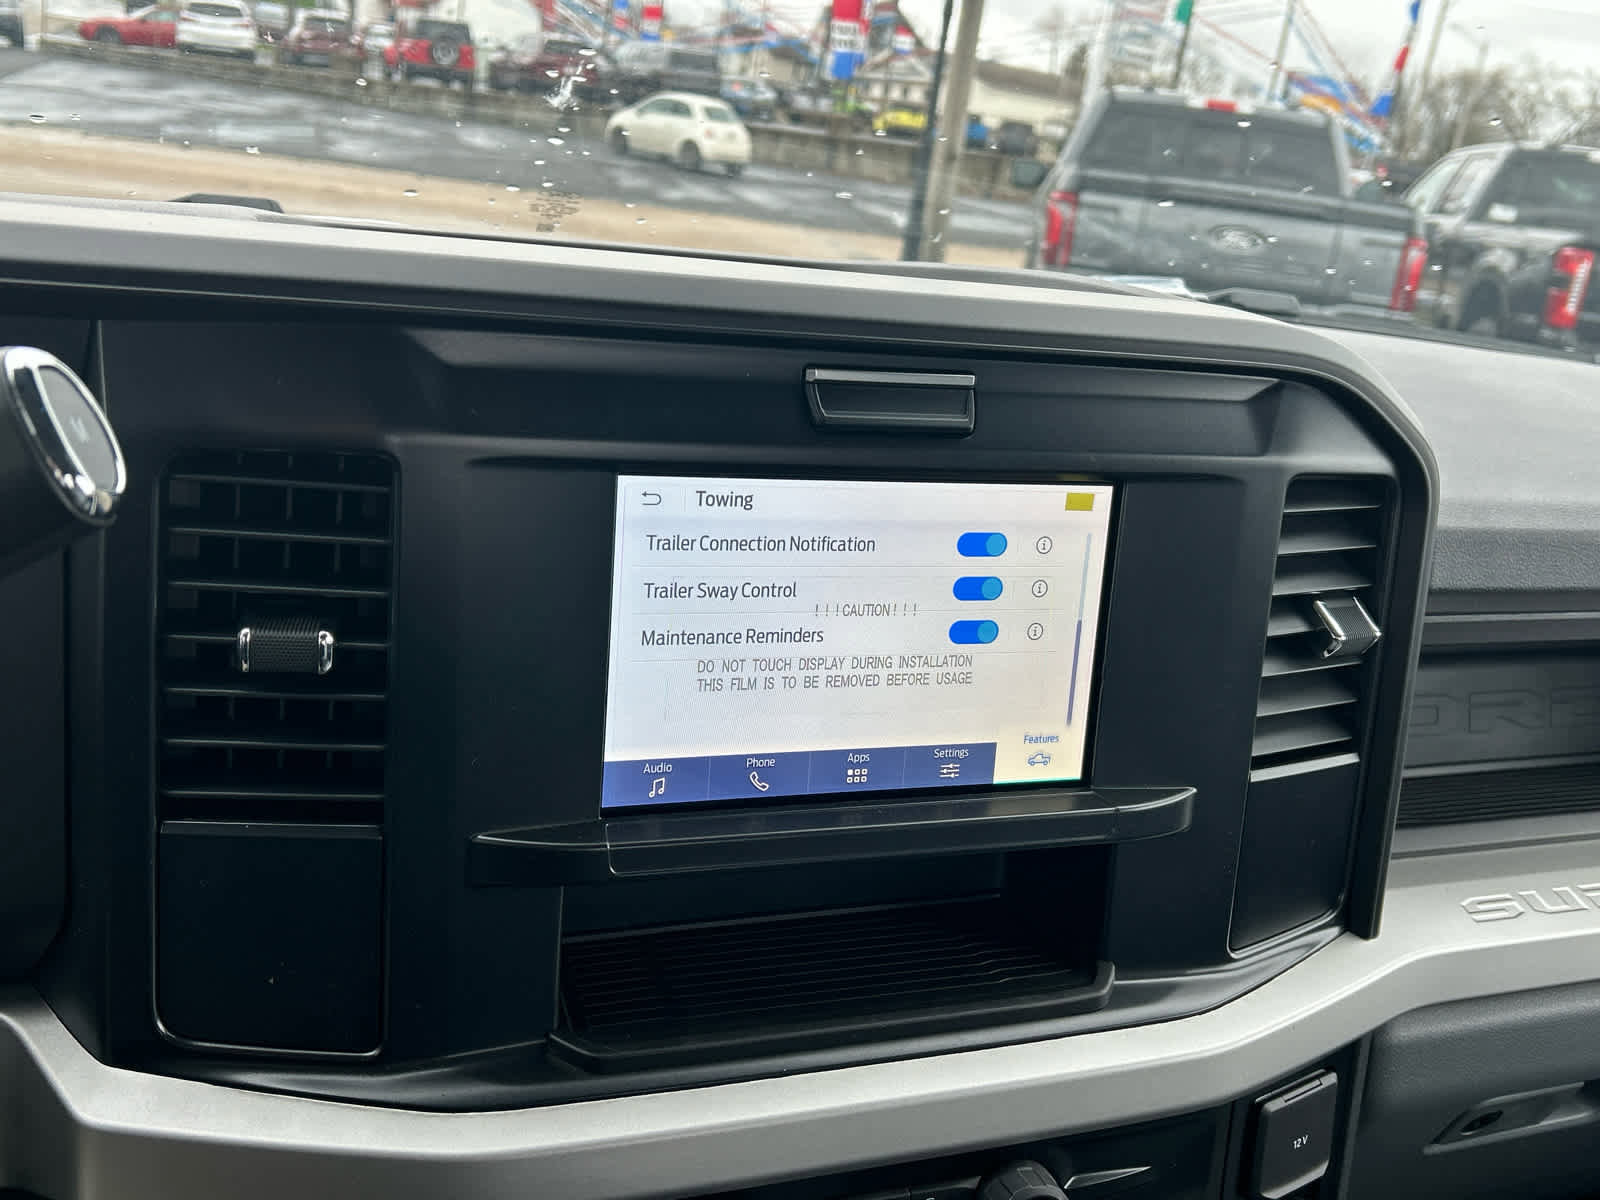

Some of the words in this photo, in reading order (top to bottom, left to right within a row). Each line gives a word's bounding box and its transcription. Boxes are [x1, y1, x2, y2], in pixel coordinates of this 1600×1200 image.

[695, 490, 754, 511] Towing
[646, 534, 697, 552] Trailer
[699, 534, 787, 553] Connection
[789, 535, 877, 553] Notification
[643, 582, 694, 600] Trailer
[697, 582, 739, 601] Sway
[741, 581, 798, 599] Control
[640, 630, 743, 646] Maintenance
[746, 627, 824, 645] Reminders
[697, 660, 715, 673] DO
[722, 659, 746, 673] NOT
[752, 658, 792, 672] TOUCH
[798, 656, 846, 671] DISPLAY
[851, 656, 893, 669] DURING
[899, 654, 973, 668] INSTALLATION
[697, 678, 723, 692] THIS
[730, 677, 757, 691] FILM
[763, 676, 775, 690] IS
[782, 675, 797, 689] TO
[804, 675, 820, 688] BE
[825, 673, 881, 688] REMOVED
[886, 672, 930, 686] BEFORE
[936, 671, 973, 685] USAGE
[1023, 734, 1060, 744] Features
[746, 756, 776, 768] Phone
[847, 752, 871, 763] Apps
[933, 747, 969, 760] Settings
[643, 762, 673, 774] Audio
